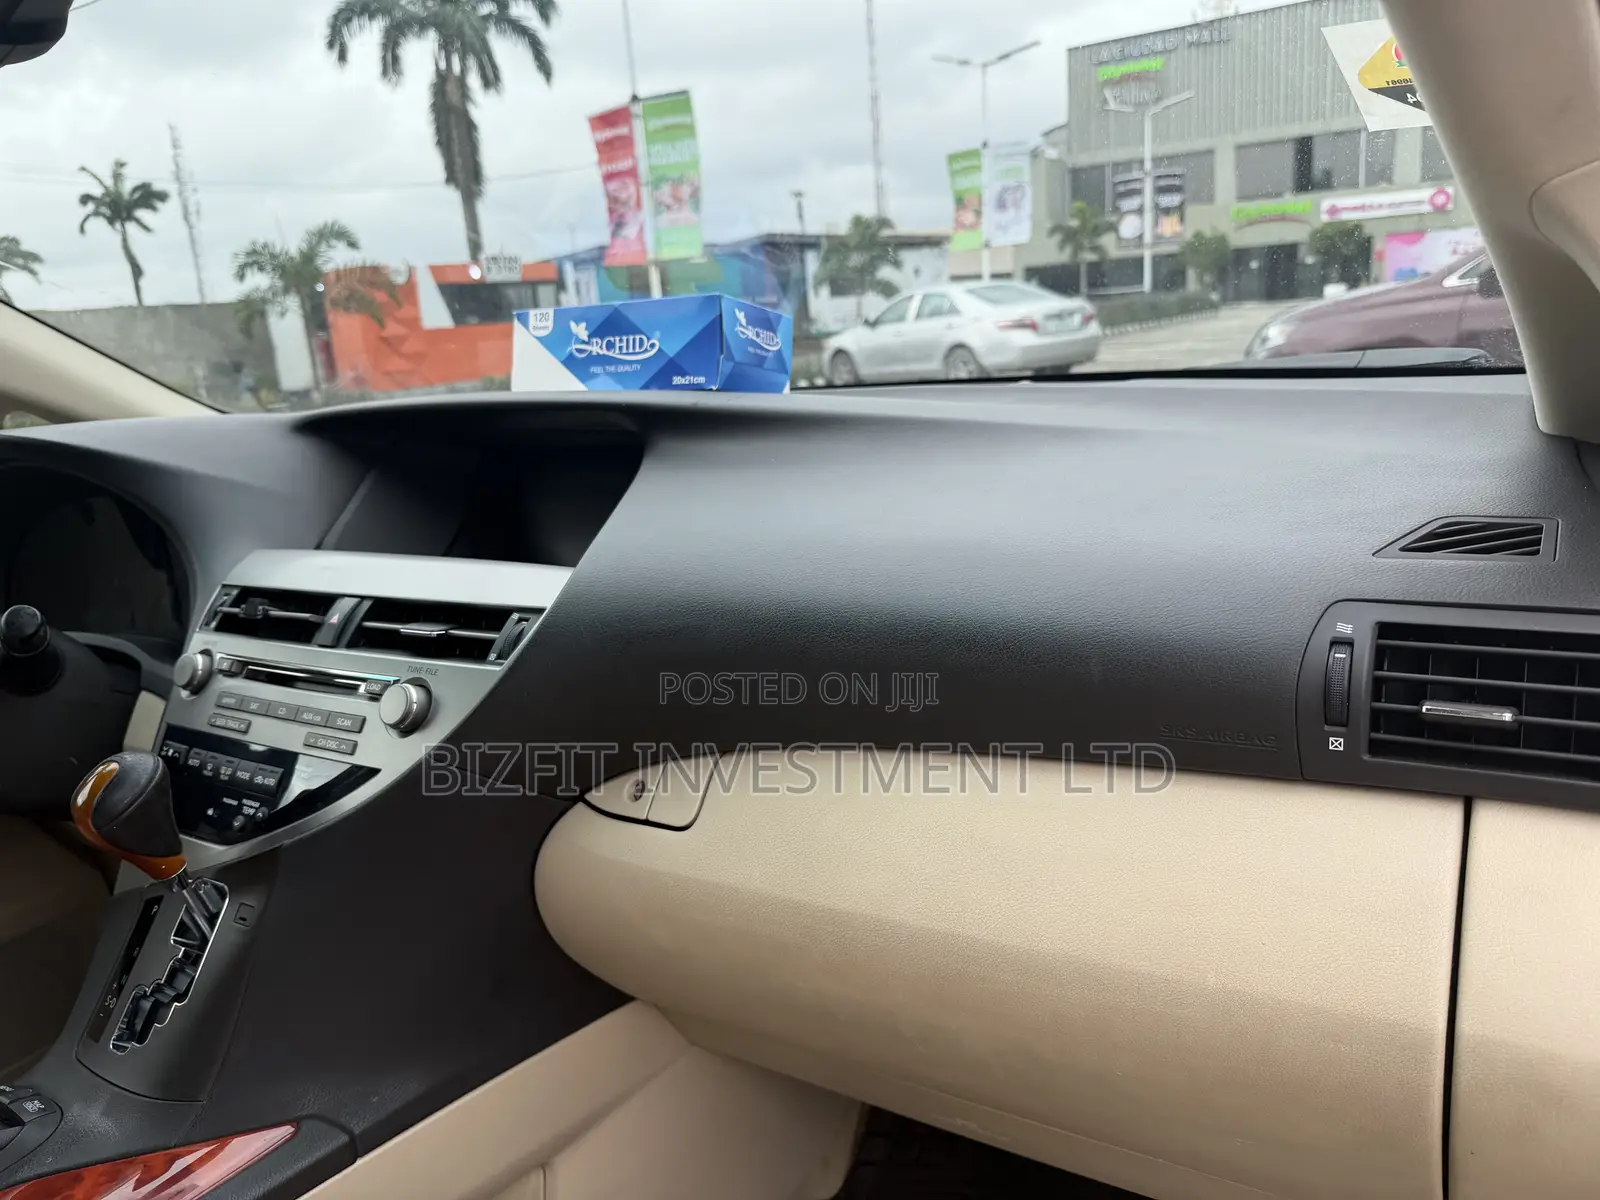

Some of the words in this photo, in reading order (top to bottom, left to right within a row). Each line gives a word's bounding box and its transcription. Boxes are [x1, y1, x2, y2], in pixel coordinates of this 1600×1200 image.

[533, 312, 550, 322] 120
[671, 375, 706, 386] 20x21cm
[366, 683, 381, 691] LOAD
[336, 718, 352, 726] SCAN
[236, 771, 251, 780] MODE
[151, 904, 159, 915] P
